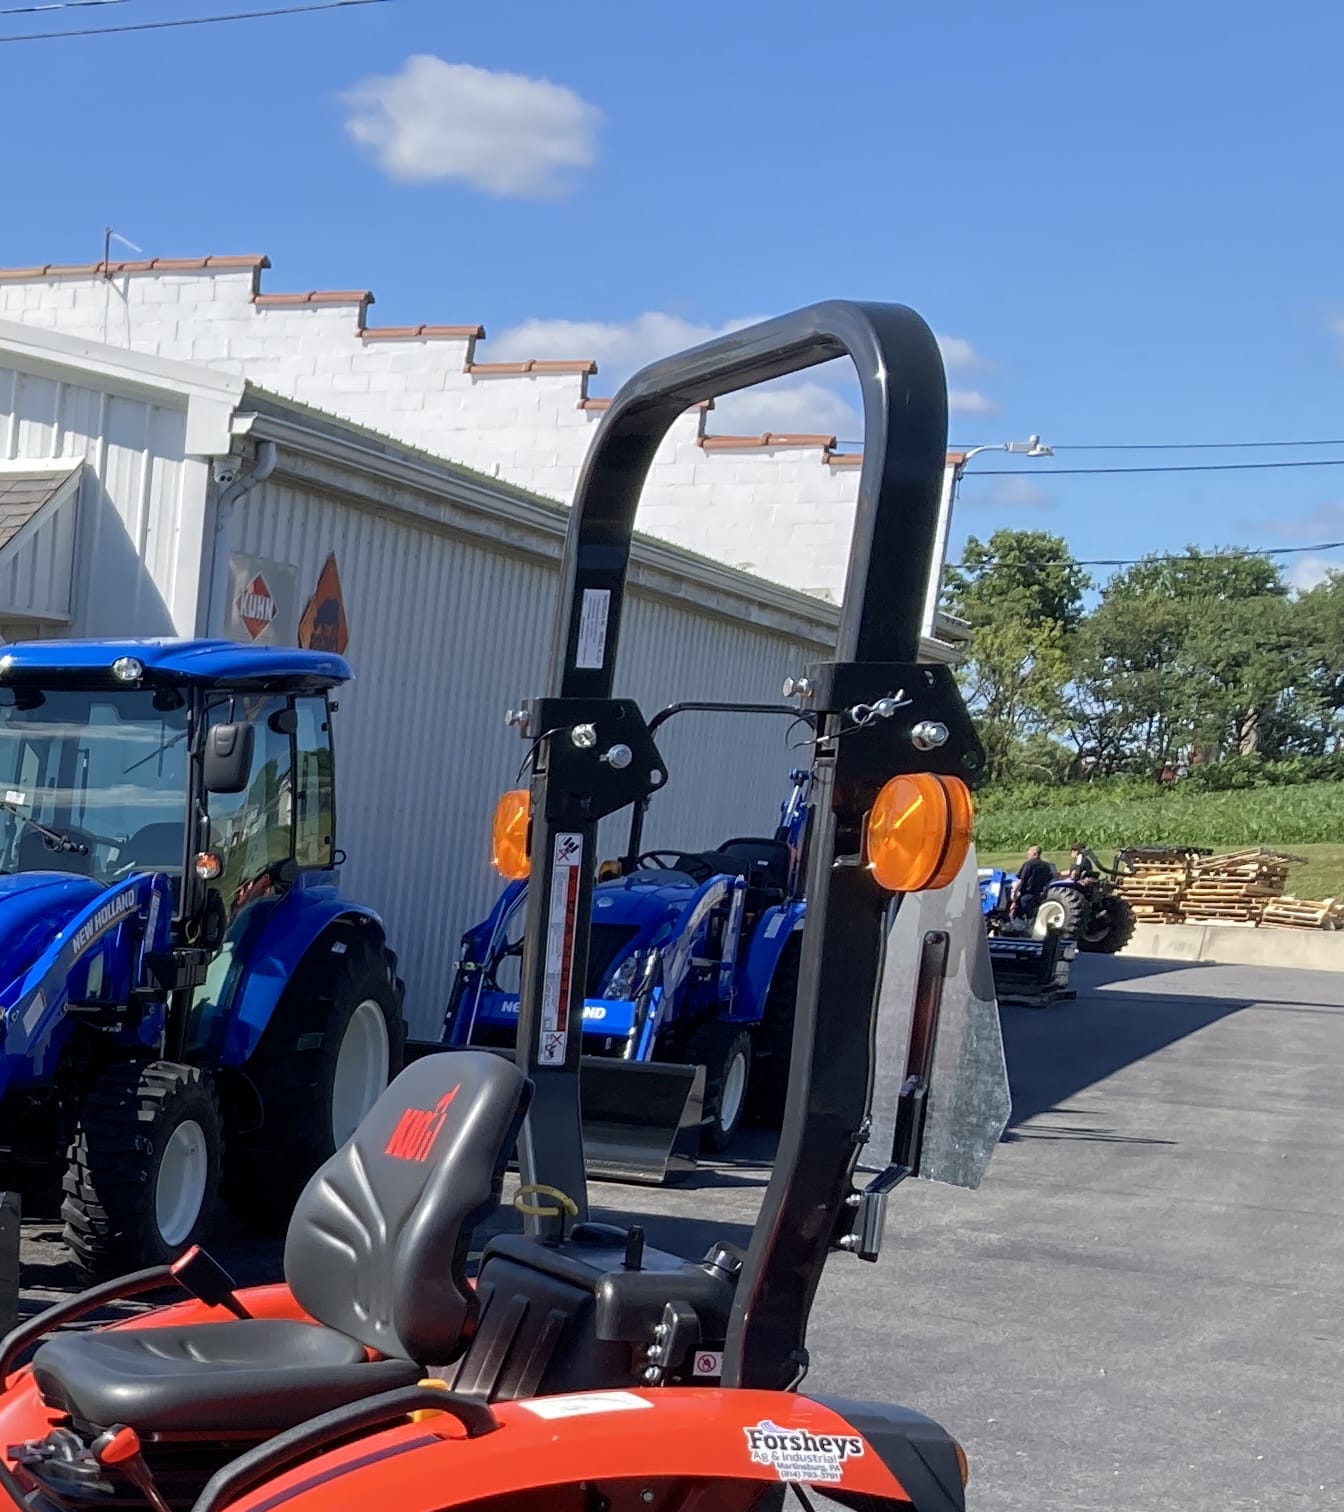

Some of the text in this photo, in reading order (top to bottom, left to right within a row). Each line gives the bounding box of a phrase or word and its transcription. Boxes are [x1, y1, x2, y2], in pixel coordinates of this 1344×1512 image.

[238, 590, 274, 621] KUHN
[72, 889, 135, 953] NEW HOLLAND
[500, 1000, 520, 1013] NE
[746, 1428, 862, 1459] Forsheys
[753, 1451, 838, 1464] Ag & Industrial
